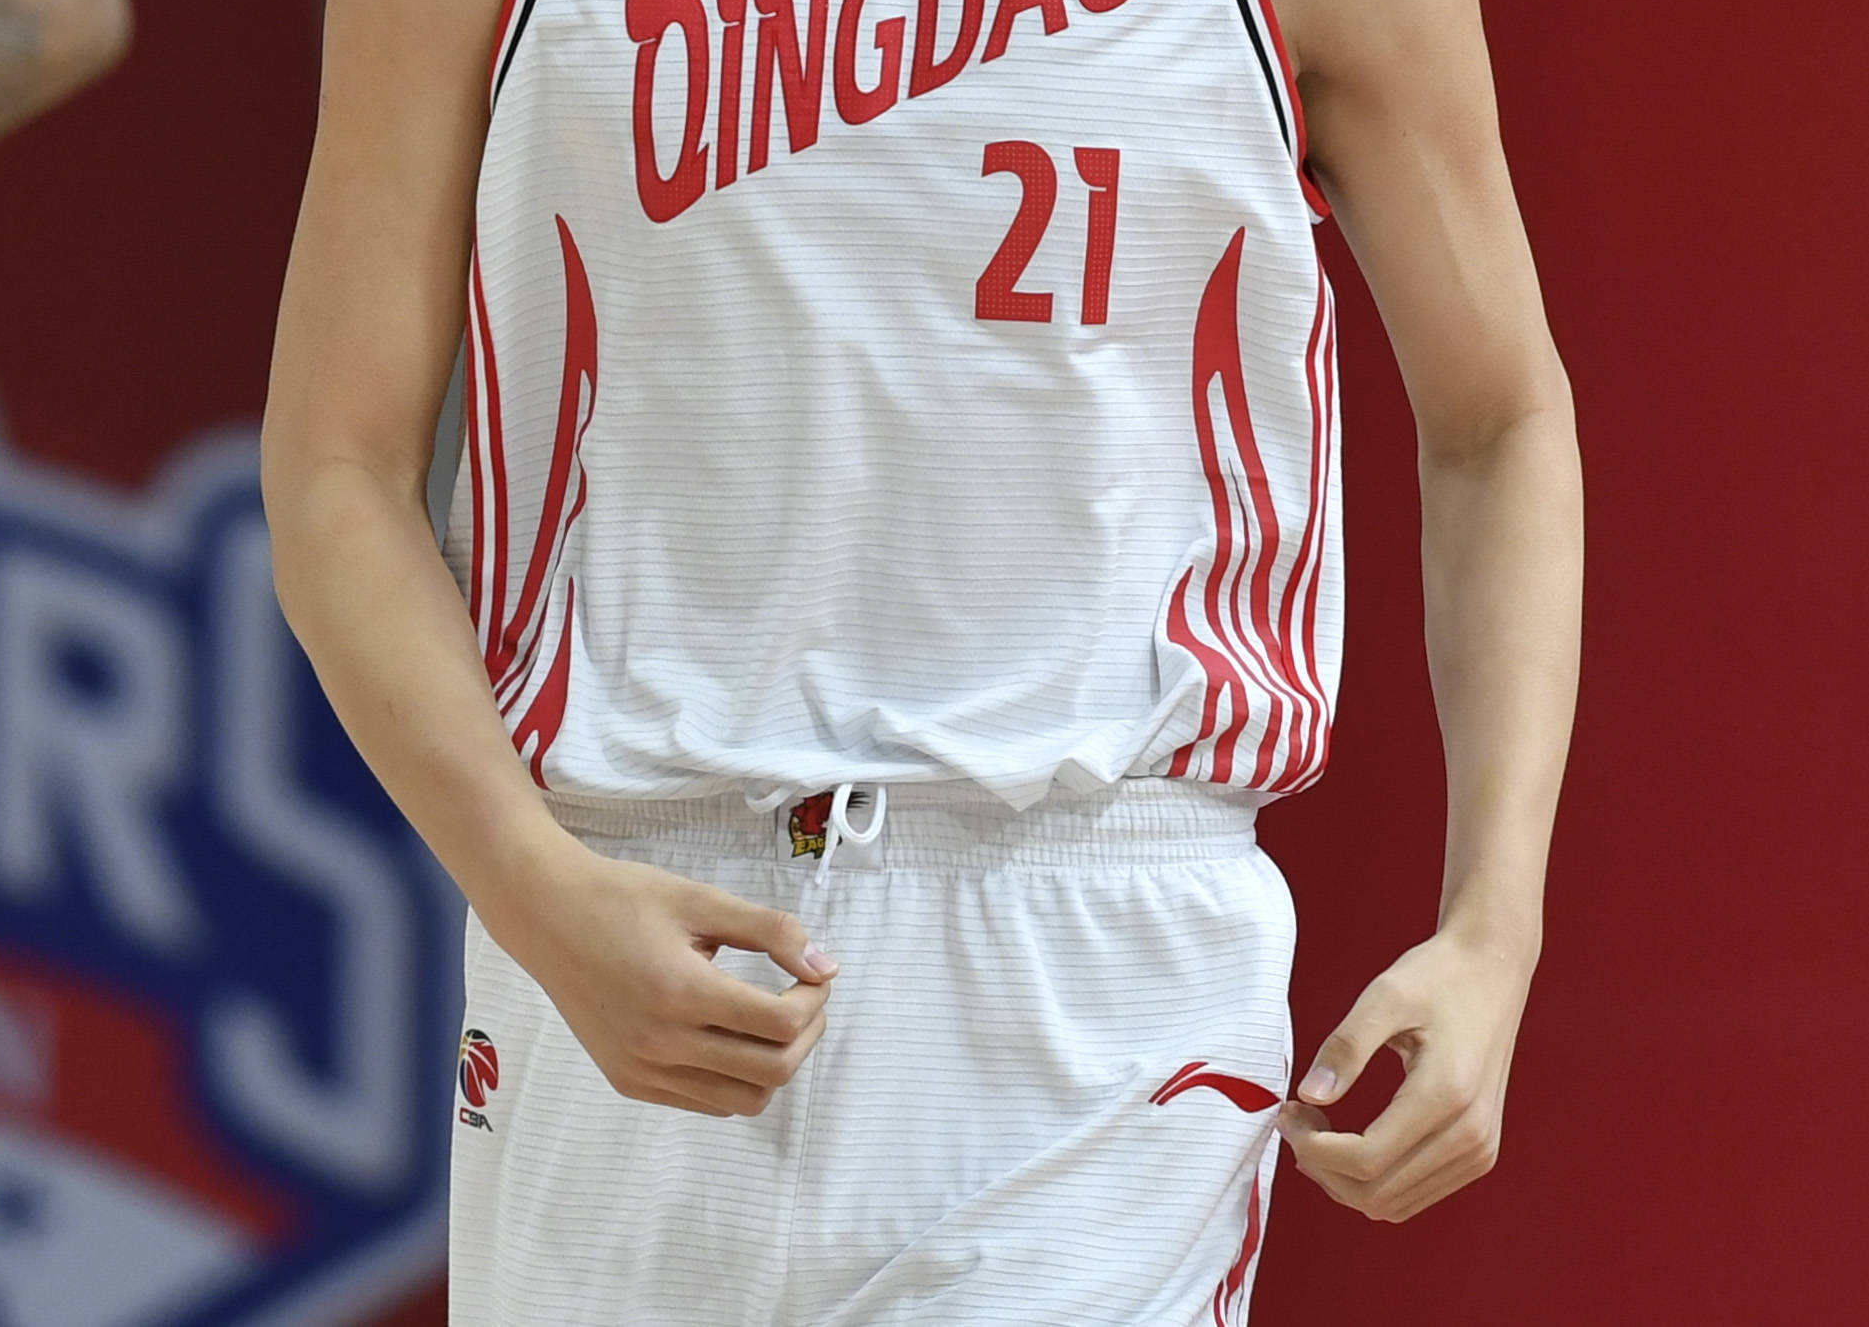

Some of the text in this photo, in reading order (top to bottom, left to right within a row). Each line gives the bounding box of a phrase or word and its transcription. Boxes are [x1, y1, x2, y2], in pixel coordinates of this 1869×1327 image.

[975, 139, 1120, 325] 21
[793, 837, 826, 856] EAG
[459, 1107, 494, 1133] CBA
